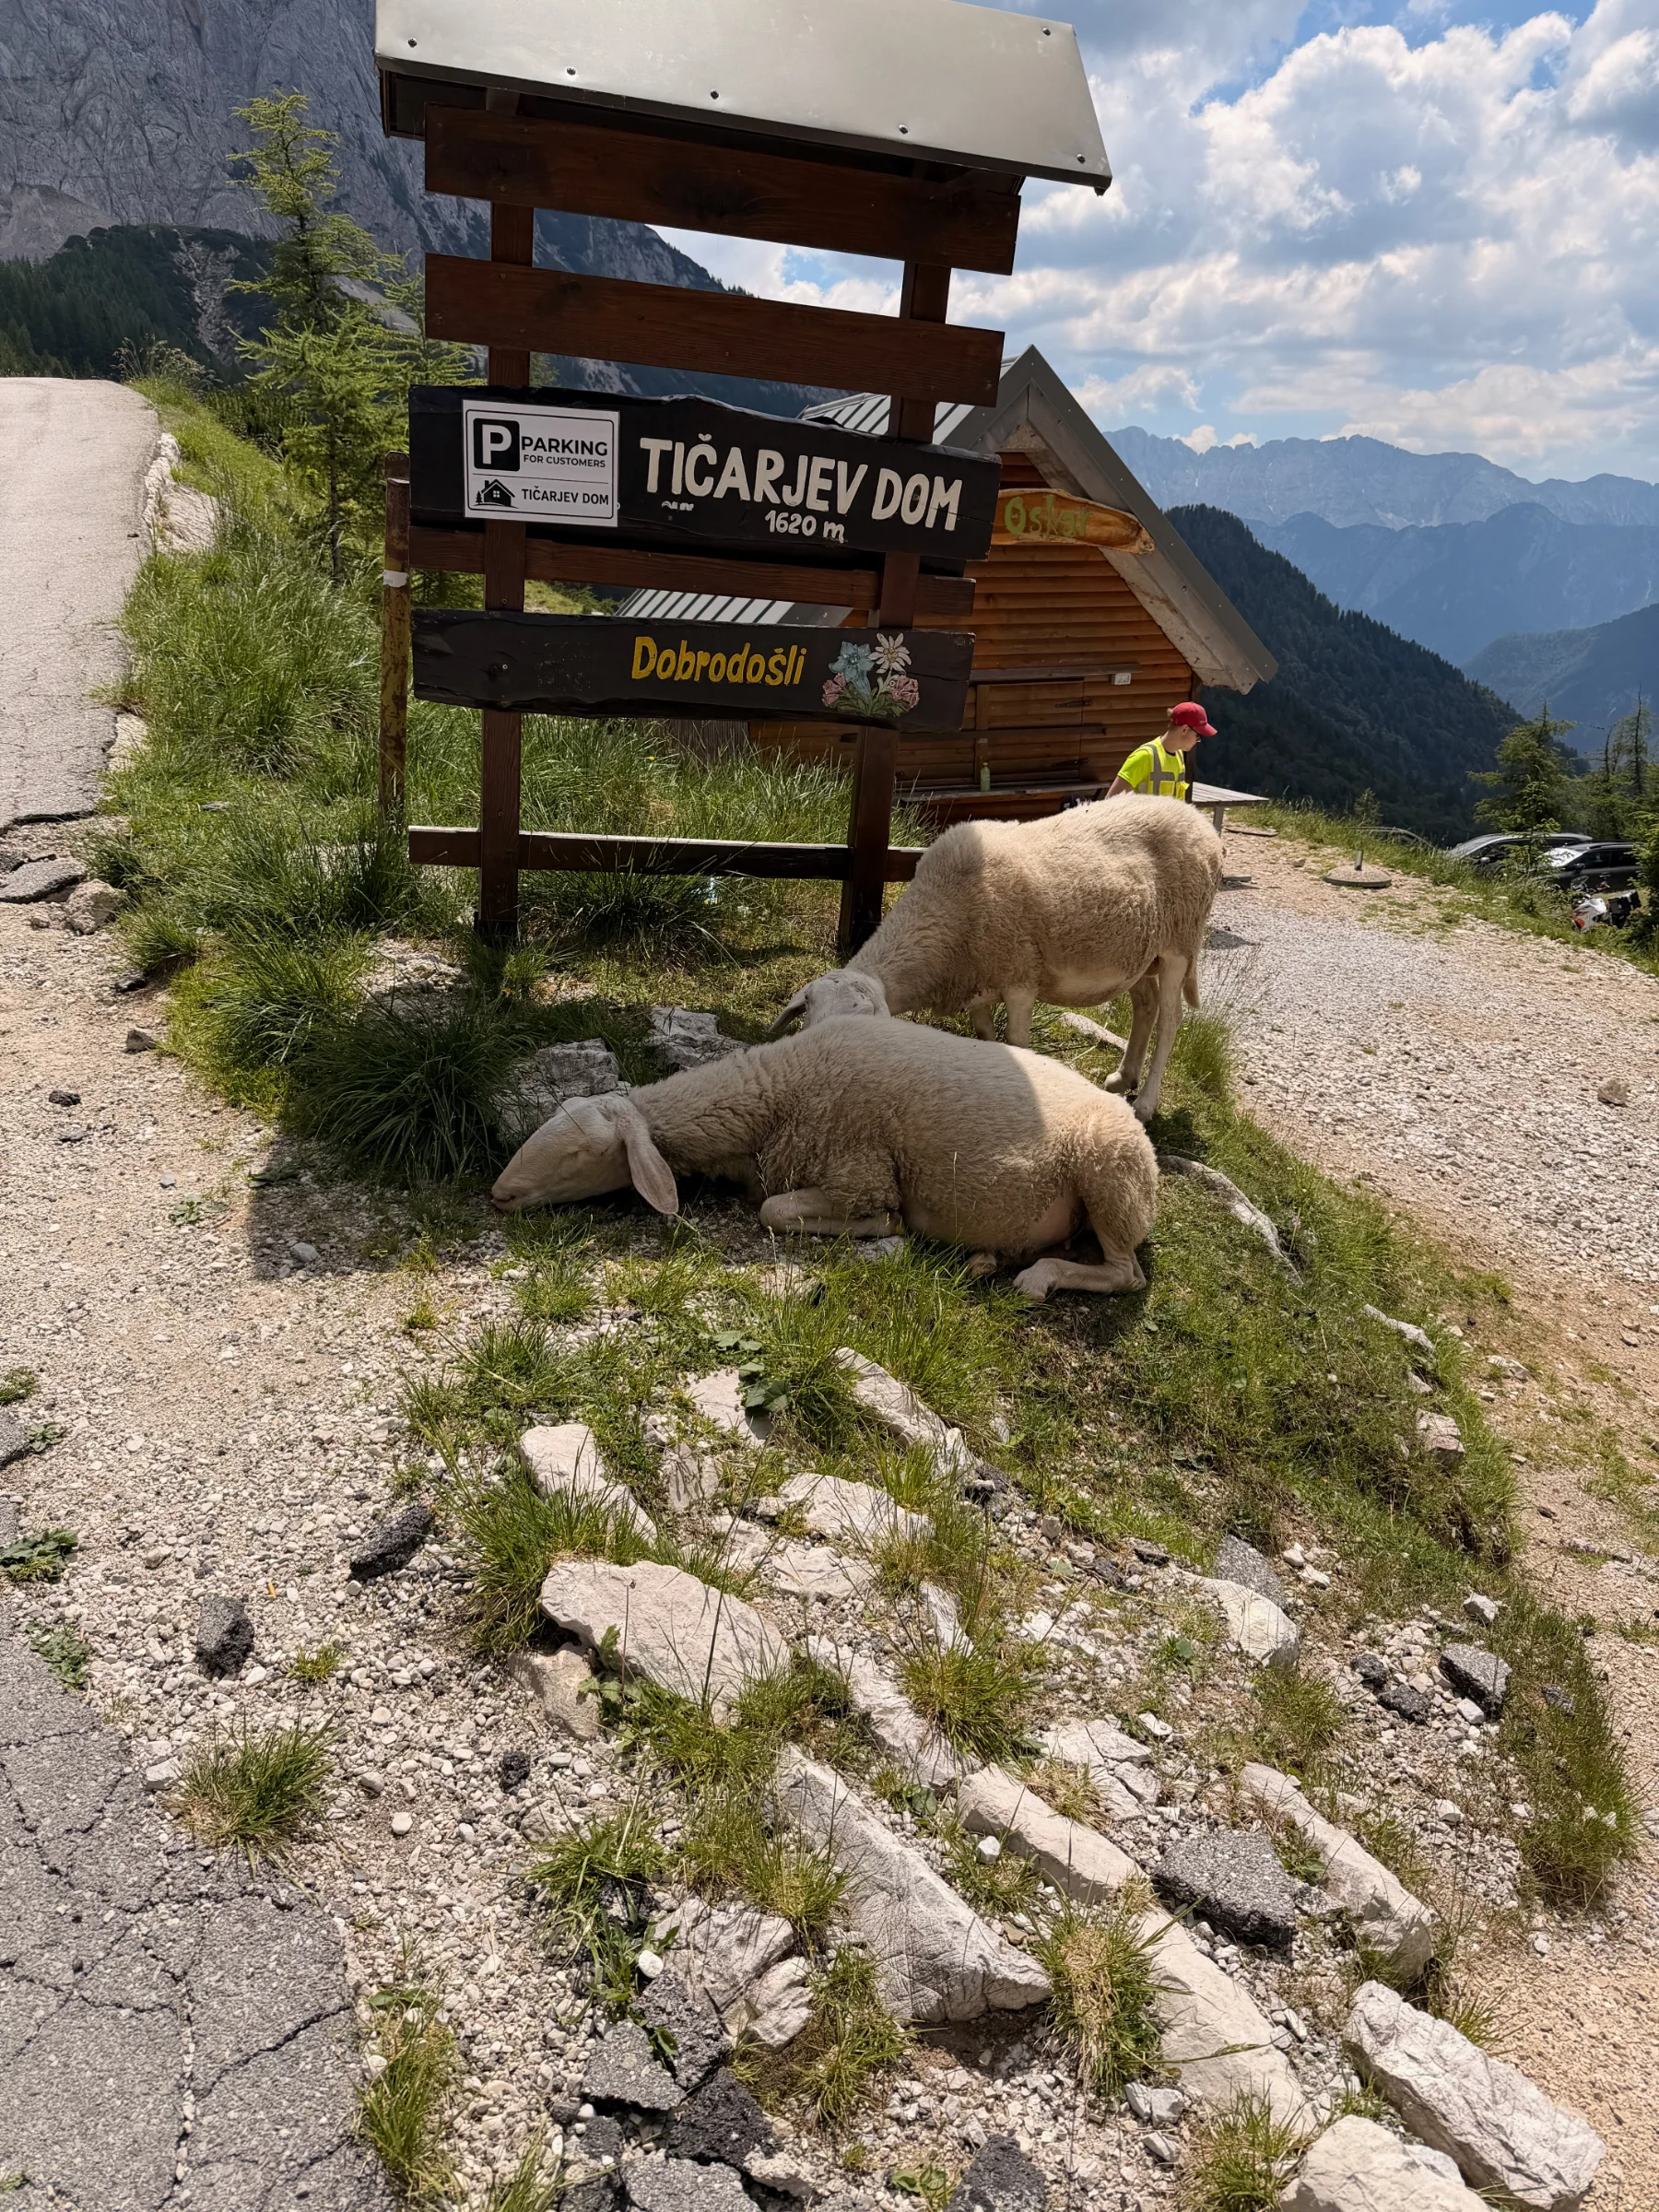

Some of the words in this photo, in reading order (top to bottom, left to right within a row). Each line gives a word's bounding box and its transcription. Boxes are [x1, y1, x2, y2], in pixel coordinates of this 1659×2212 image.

[481, 423, 512, 465] P
[521, 436, 608, 456] PARKING
[523, 454, 544, 464] FOR
[546, 456, 606, 468] CUSTOMERS
[521, 486, 579, 503] TIČARJEV
[582, 493, 609, 506] DOM
[640, 432, 868, 514] TIČARJEV
[871, 467, 963, 532] DOM
[764, 510, 818, 537] 1620
[822, 522, 845, 543] m
[1004, 493, 1092, 537] Oskar
[631, 636, 808, 685] Dobrodošli
